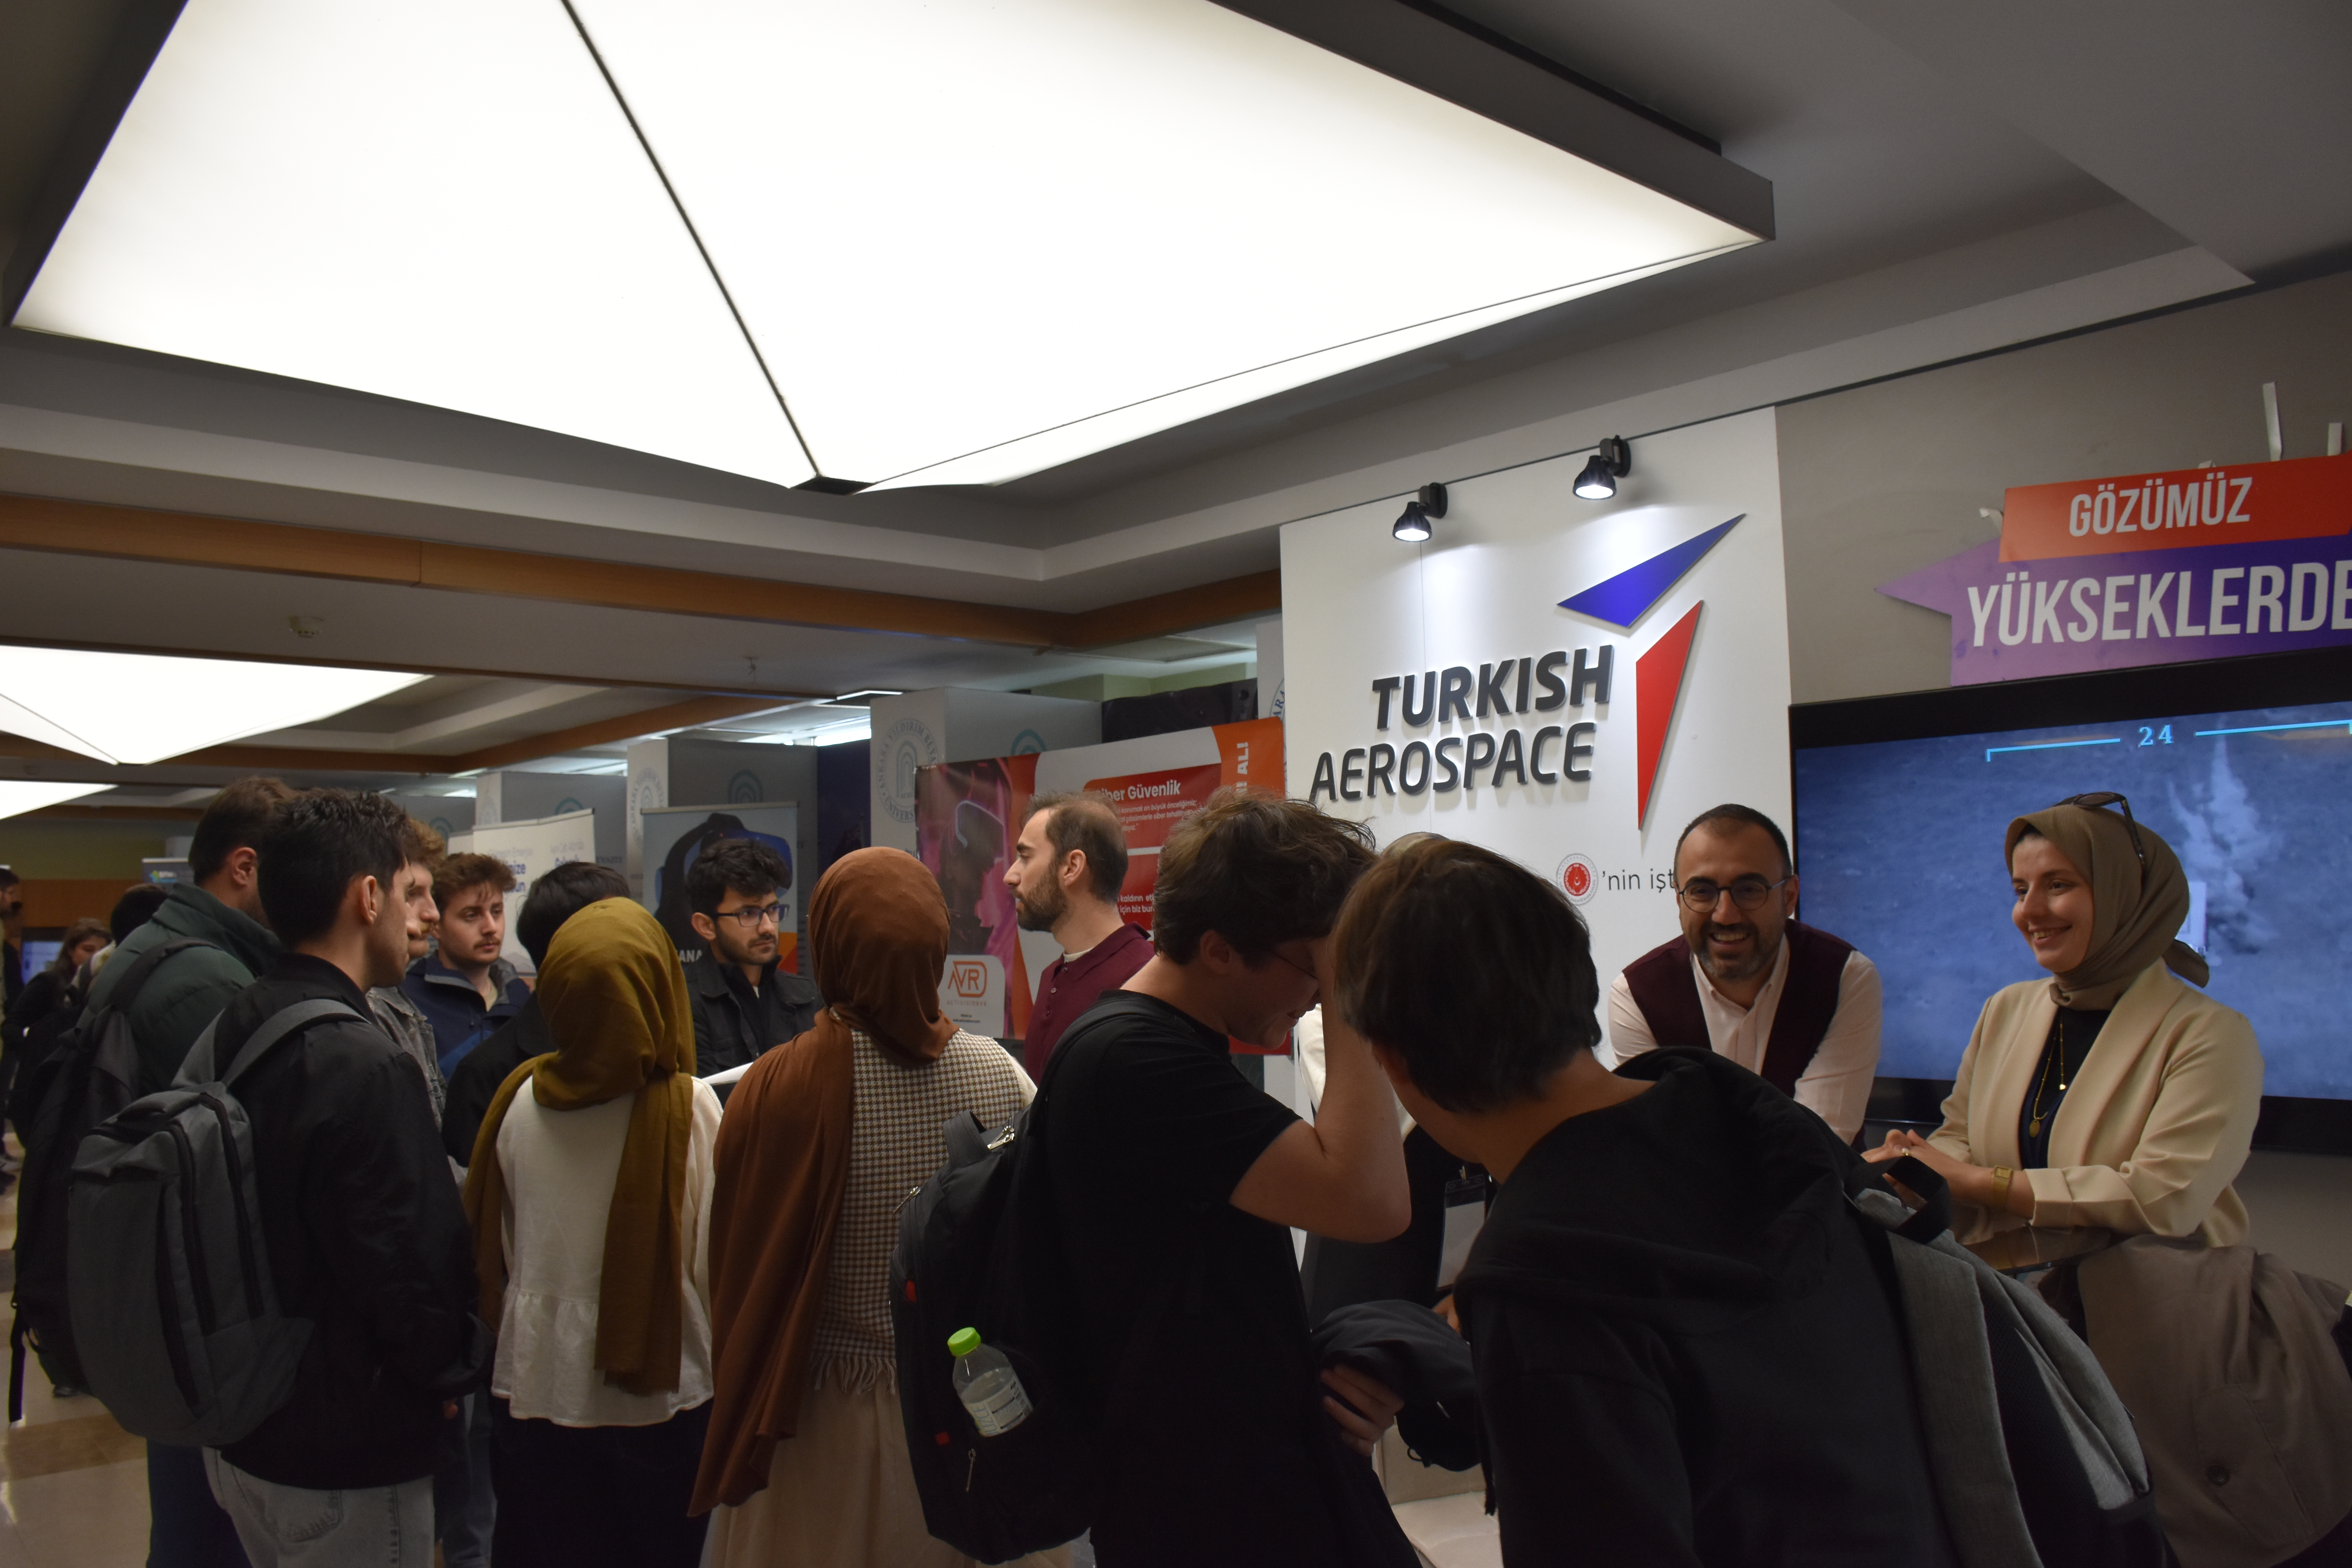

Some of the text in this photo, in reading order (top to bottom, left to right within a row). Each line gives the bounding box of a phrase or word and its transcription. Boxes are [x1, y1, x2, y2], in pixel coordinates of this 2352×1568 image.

[2069, 472, 2253, 537] GÖZÜMÜZ
[1967, 559, 2352, 648] YÜKSEKLERDE
[1372, 644, 1614, 730] TURKISH
[2139, 724, 2172, 746] 24
[1308, 722, 1597, 802] AEROSPACE
[1127, 779, 1181, 800] Güvenlik
[1151, 803, 1166, 811] büyük
[1650, 868, 1675, 893] işt
[1120, 905, 1131, 915] için
